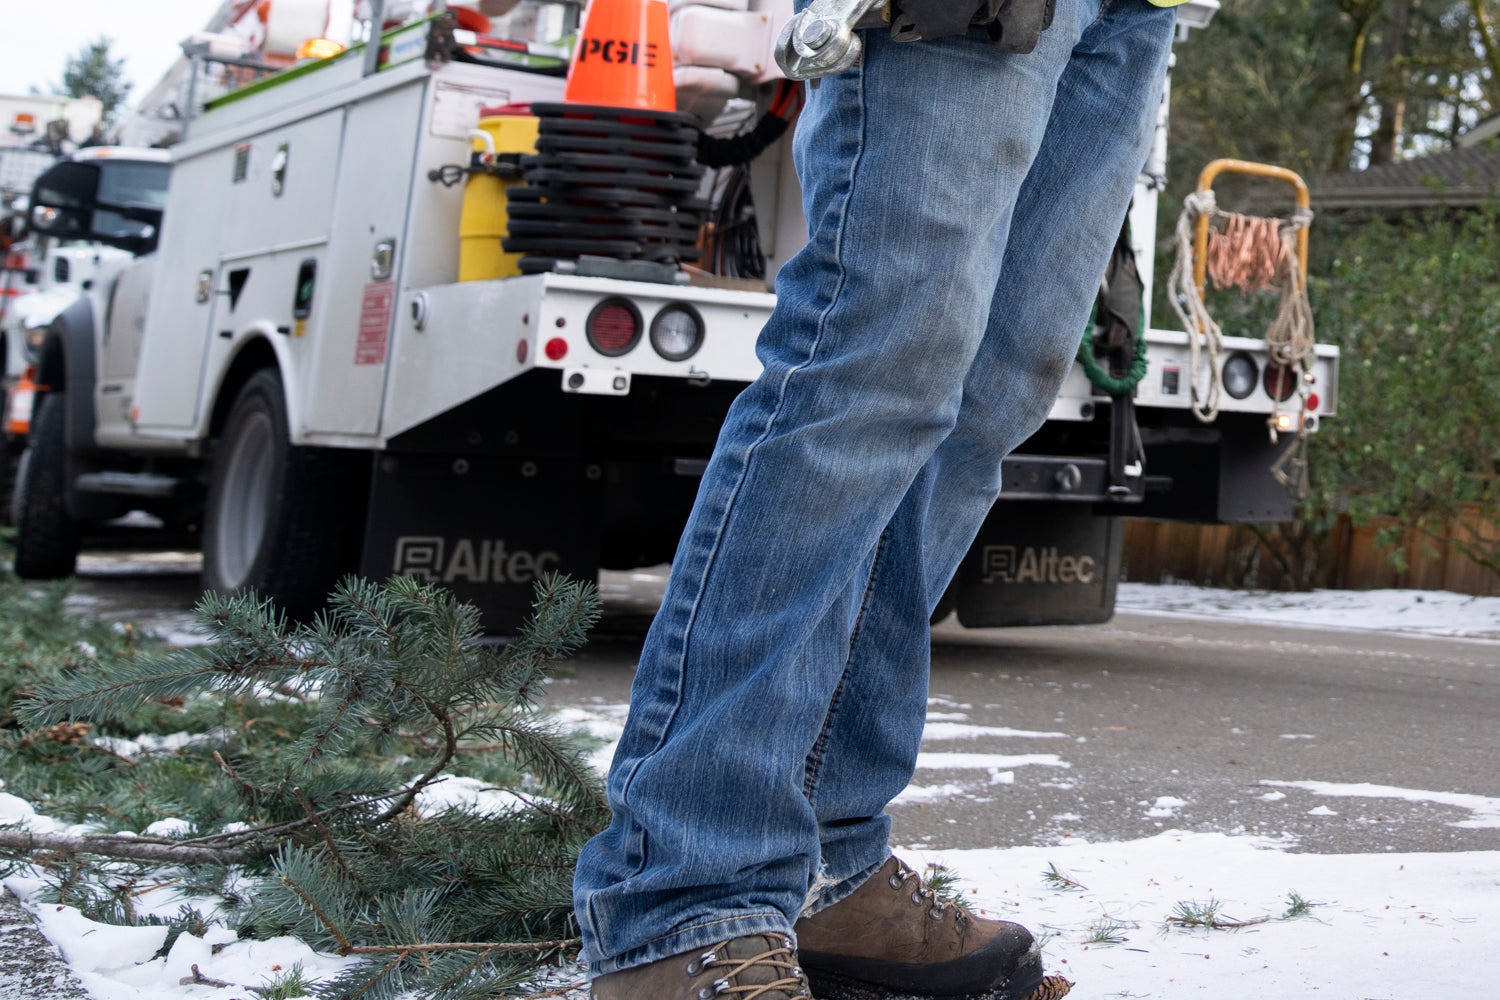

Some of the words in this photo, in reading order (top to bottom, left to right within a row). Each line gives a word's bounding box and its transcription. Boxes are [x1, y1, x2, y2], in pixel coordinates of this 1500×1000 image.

[579, 38, 658, 67] PGE
[444, 538, 561, 584] Altec
[1016, 546, 1096, 584] Altec
